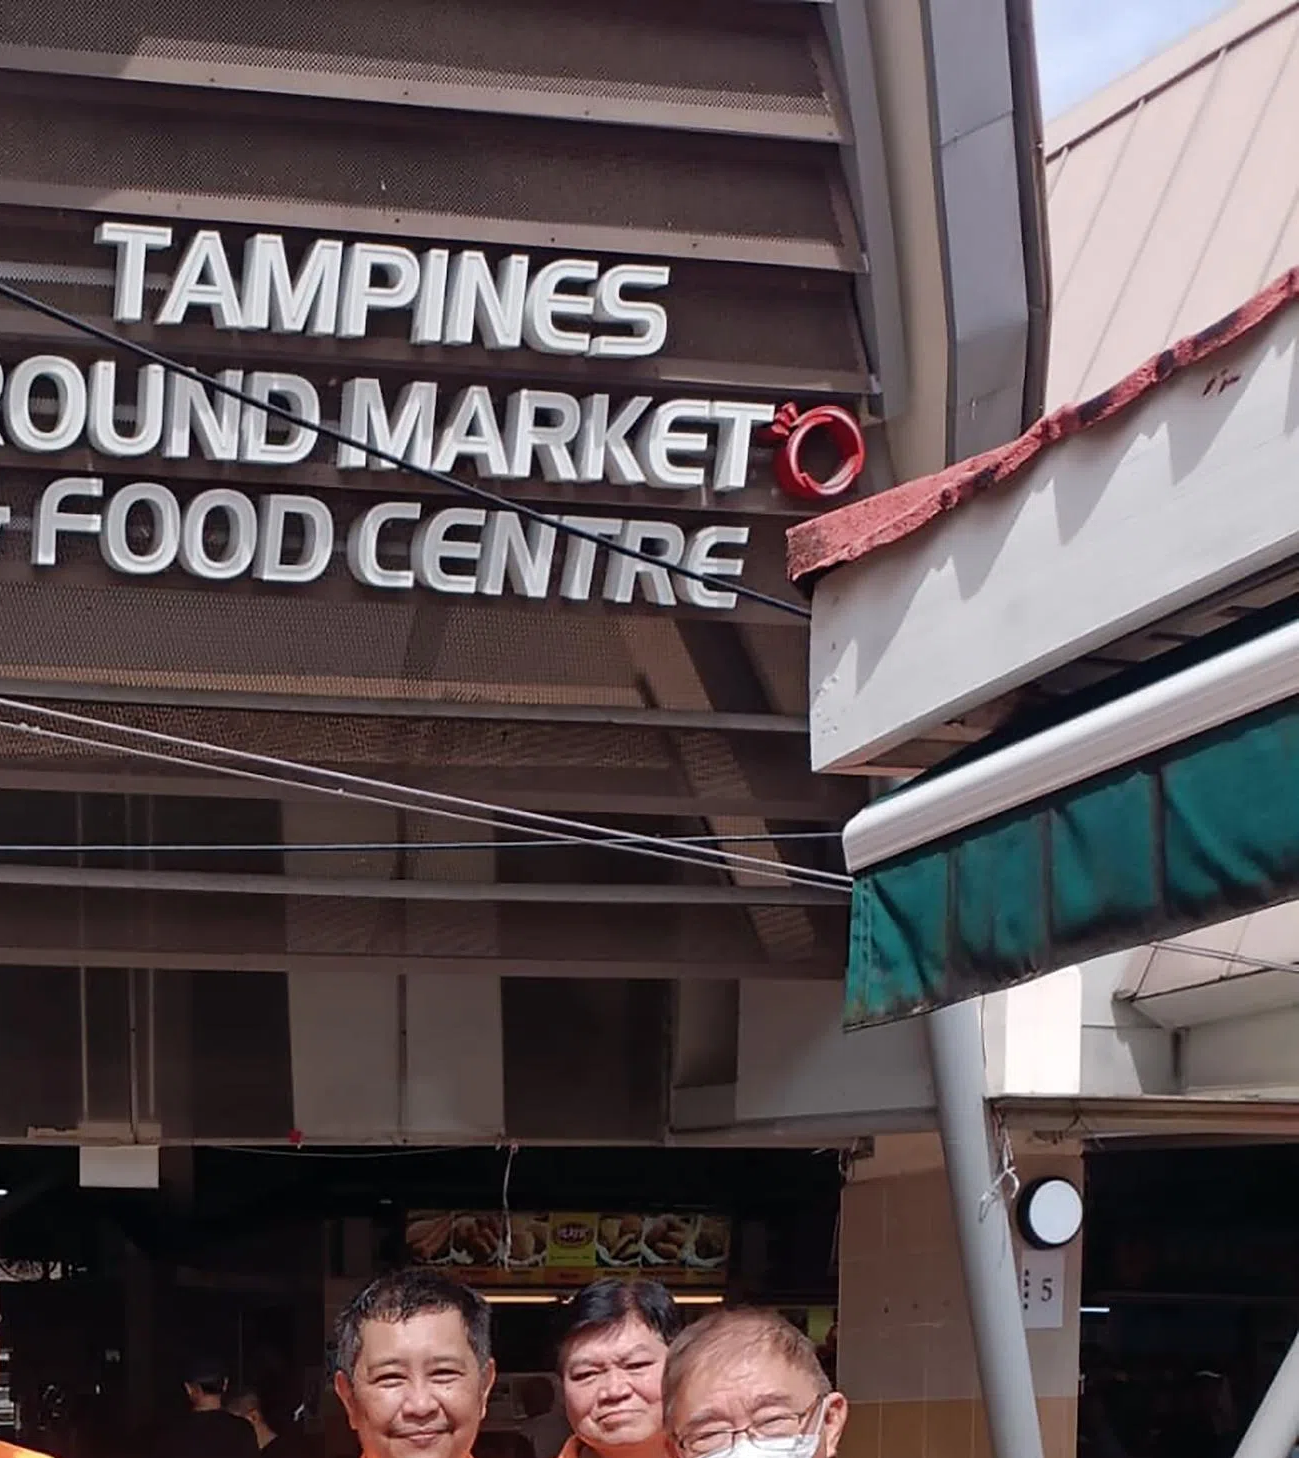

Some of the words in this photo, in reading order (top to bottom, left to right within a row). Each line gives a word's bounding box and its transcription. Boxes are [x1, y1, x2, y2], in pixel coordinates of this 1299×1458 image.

[95, 222, 669, 358] TAMPINES
[337, 377, 775, 492] MARKET
[31, 476, 334, 583] FOOD
[347, 501, 750, 609] CENTRE
[1041, 1277, 1053, 1302] 5
